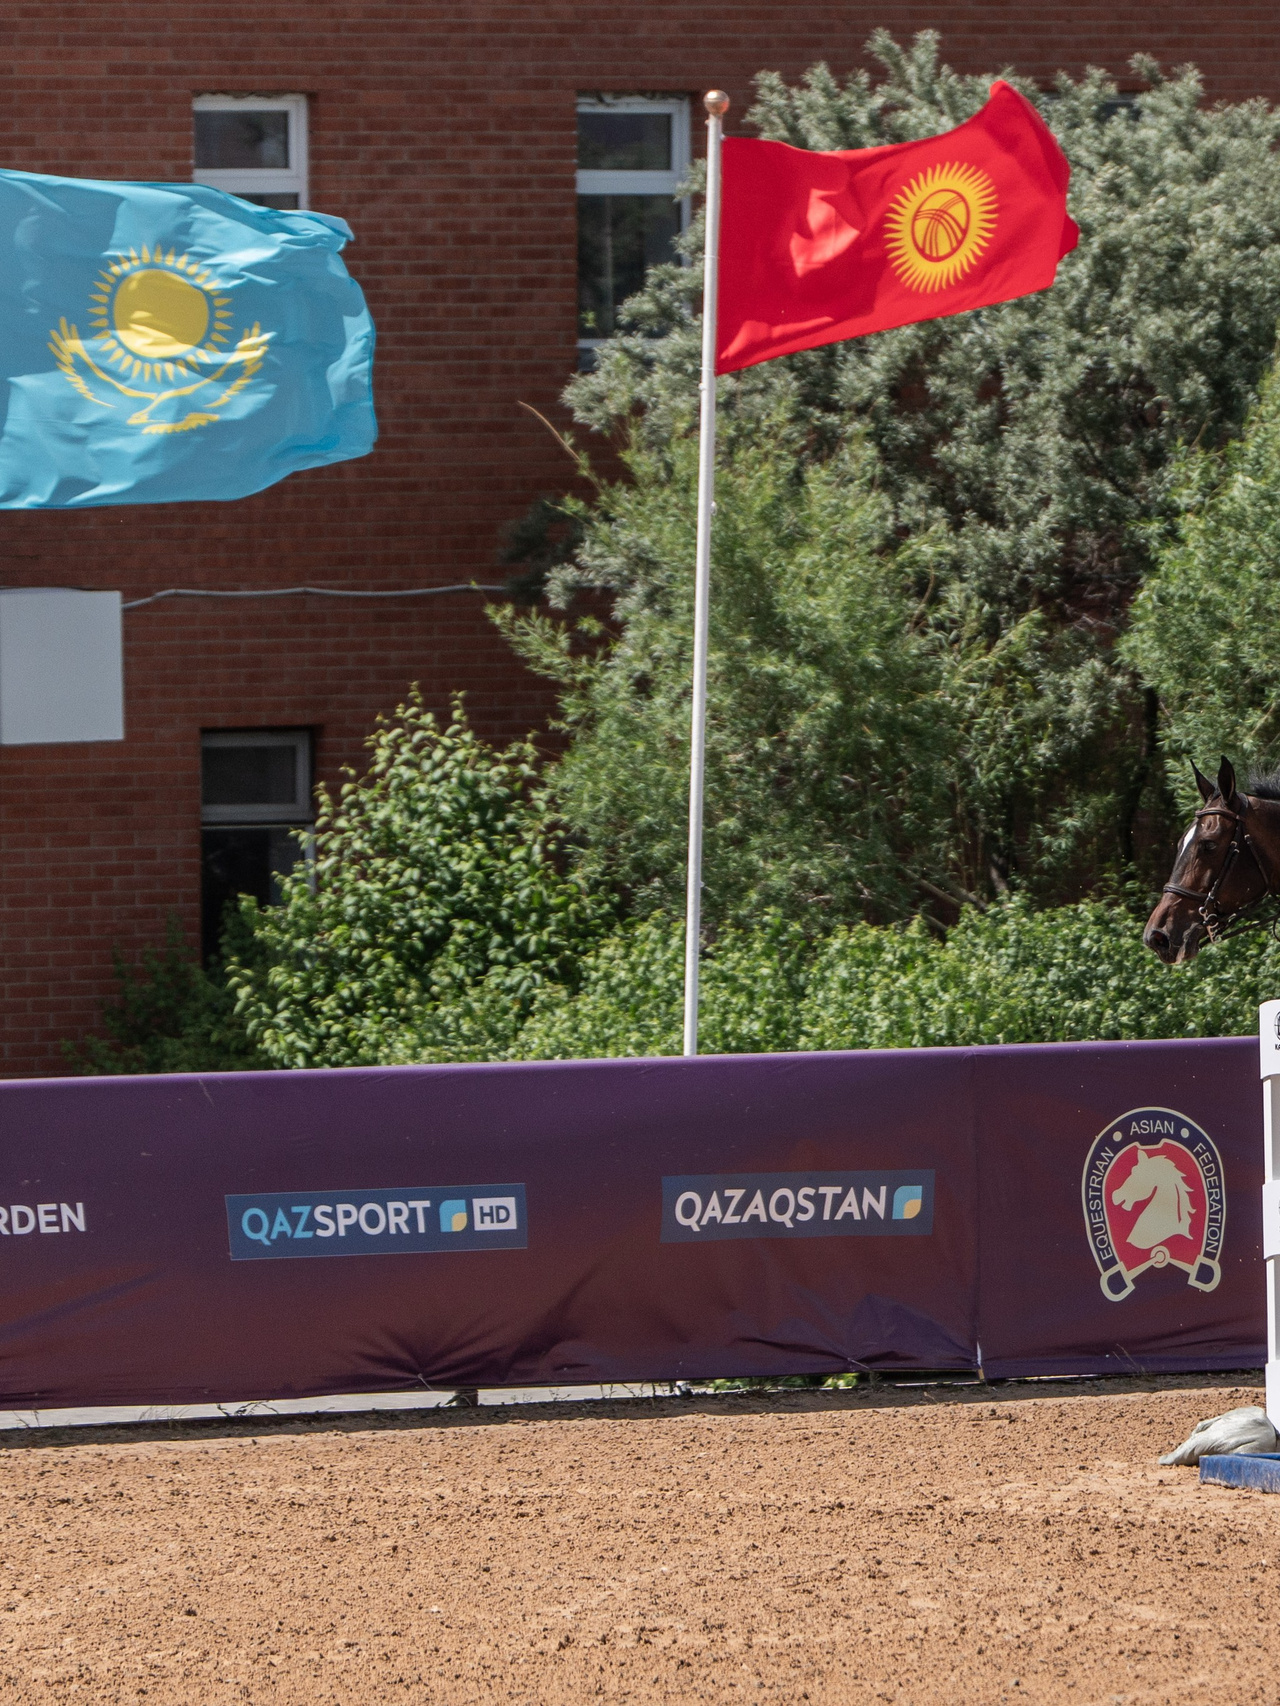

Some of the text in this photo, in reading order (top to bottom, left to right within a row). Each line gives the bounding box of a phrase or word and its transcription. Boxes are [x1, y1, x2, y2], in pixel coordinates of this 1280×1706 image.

[675, 1185, 887, 1231] QAZAQSTAN
[1089, 1120, 1221, 1260] EQUESTRIAN ASIAN FEDERATION
[241, 1200, 511, 1245] QAZSPORT HD
